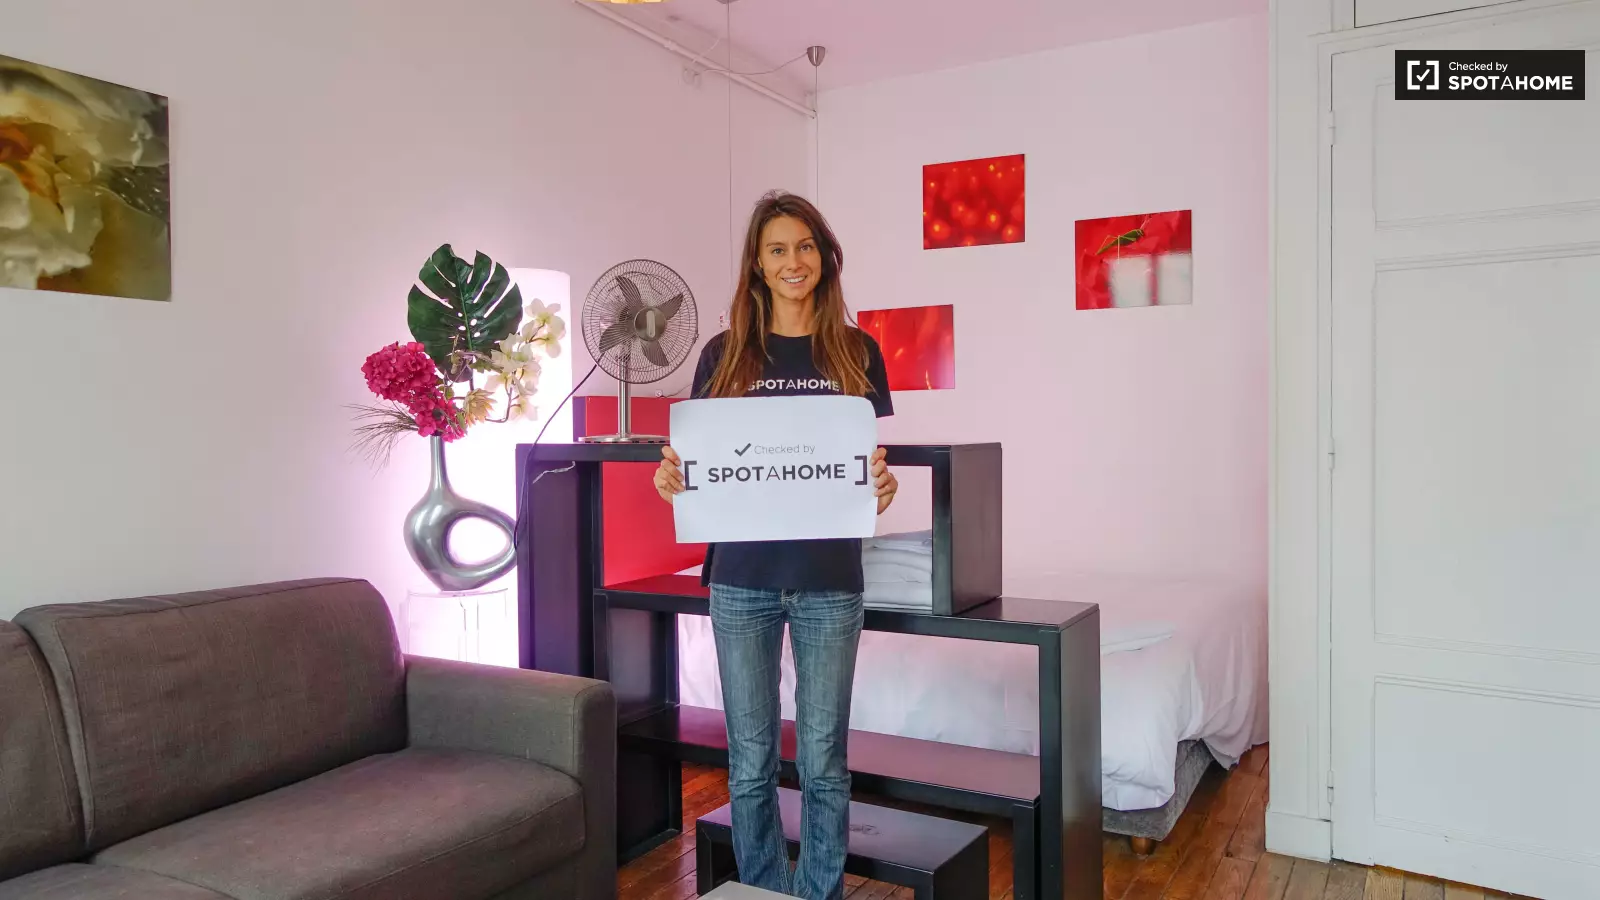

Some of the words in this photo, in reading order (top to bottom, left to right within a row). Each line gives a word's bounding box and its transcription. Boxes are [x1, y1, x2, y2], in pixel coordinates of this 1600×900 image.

[754, 444, 800, 455] Checked
[803, 443, 815, 455] by
[707, 463, 846, 483] SPOTAHOME
